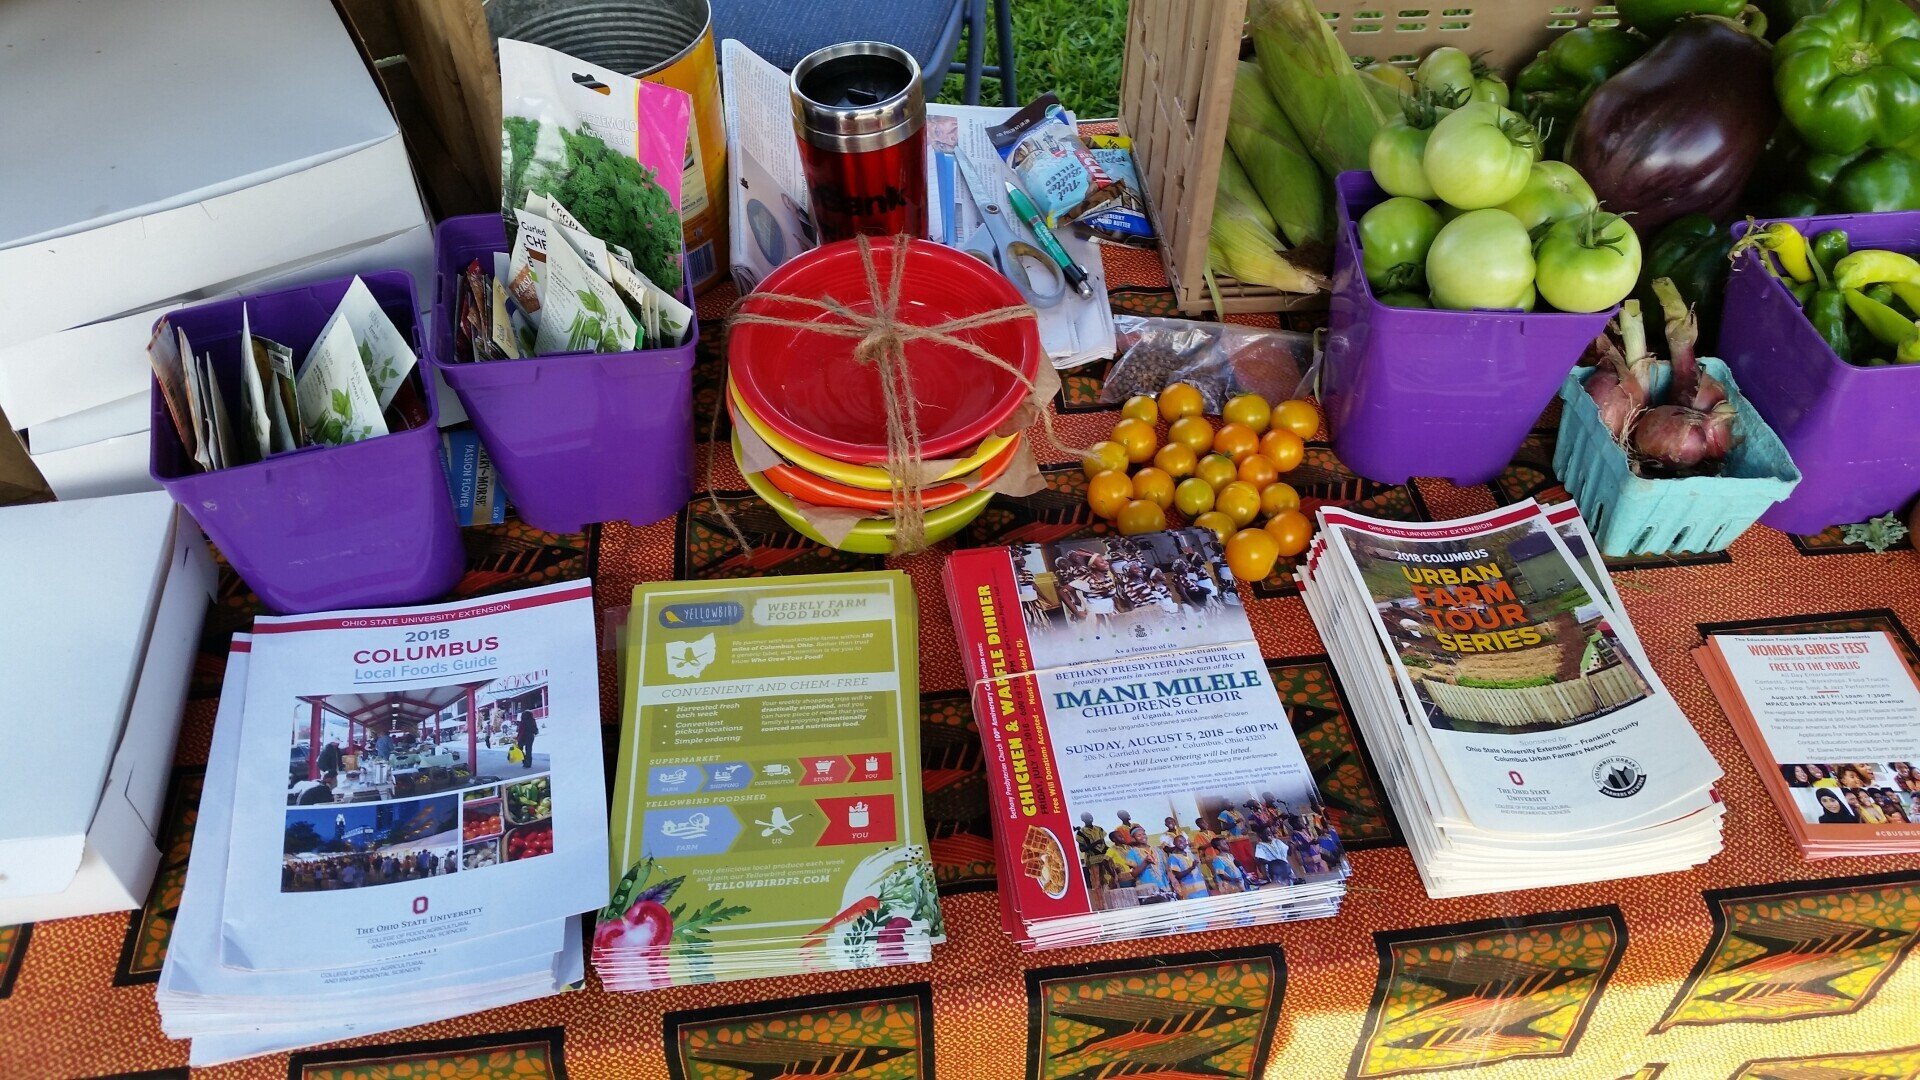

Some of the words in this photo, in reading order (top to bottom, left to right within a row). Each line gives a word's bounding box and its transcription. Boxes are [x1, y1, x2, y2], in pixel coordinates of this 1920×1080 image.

[521, 221, 546, 237] Curled
[463, 444, 475, 476] PASSION
[460, 478, 472, 508] FLOWER
[1368, 524, 1385, 533] OHIO
[1385, 527, 1406, 536] STATE
[1450, 522, 1493, 535] EXTENSION
[1397, 551, 1422, 563] 2018
[1423, 548, 1489, 563] COLUMBUS
[1401, 562, 1503, 585] URBAN
[1410, 581, 1517, 607] FARM
[342, 619, 367, 627] OHIO
[370, 618, 398, 626] STATE
[401, 612, 456, 624] UNIVERSITY
[458, 603, 511, 618] EXTENSION
[684, 605, 738, 620] YELLOWBIRD
[767, 601, 824, 612] WEEKLY
[829, 599, 867, 609] FARM
[767, 611, 808, 621] FOOD
[812, 609, 841, 618] BOX
[978, 585, 1001, 645] DINNER
[1423, 603, 1529, 632] TOUR
[405, 628, 450, 643] 2018
[1436, 626, 1542, 652] SERIES
[353, 636, 499, 664] COLUMBUS
[1019, 650, 1027, 658] by
[1132, 645, 1156, 653] feature
[1747, 644, 1794, 656] WOMEN
[1795, 644, 1804, 655] &
[1841, 642, 1870, 653] FEST
[355, 666, 396, 680] Local
[401, 663, 448, 677] Foods
[453, 655, 497, 670] Guide
[1055, 667, 1110, 681] BETHANY
[1111, 657, 1196, 674] PRESBYTERIAN
[1198, 653, 1245, 665] CHURCH
[1769, 663, 1792, 672] FREE
[1793, 662, 1805, 671] TO
[1806, 662, 1825, 671] THE
[1826, 661, 1861, 670] PUBLIC
[661, 684, 754, 698] CONVENIENT
[756, 682, 787, 692] AND
[790, 677, 869, 691] CHEM-FREE
[990, 649, 1015, 716] WAFFLE
[1053, 683, 1151, 710] IMANI
[1153, 669, 1262, 698] MILELE
[1073, 678, 1101, 687] proudly
[1102, 675, 1133, 684] presents
[1026, 686, 1036, 704] Music
[1082, 698, 1182, 718] CHILDRENS
[1185, 690, 1243, 706] CHOIR
[677, 704, 718, 712] Harvested
[987, 691, 999, 727] Anniversary
[1142, 711, 1173, 721] Uganda,
[675, 720, 723, 728] Convenient
[675, 727, 704, 736] pickup
[705, 725, 743, 733] locations
[1006, 720, 1020, 732] &
[1033, 714, 1046, 745] Accepted
[674, 738, 703, 746] Simple
[1065, 740, 1126, 756] SUNDAY,
[1128, 733, 1183, 748] AUGUST
[1185, 732, 1197, 741] 5,
[1198, 728, 1224, 739] 2018
[1235, 724, 1258, 735] 6:00
[1260, 722, 1279, 732] PM
[1109, 749, 1140, 758] Garfield
[1142, 746, 1170, 755] Avenue
[1182, 740, 1224, 750] Columbus,
[1225, 736, 1244, 745] Ohio
[1244, 733, 1267, 742] 43203
[1466, 745, 1482, 753] Ohio
[1501, 746, 1536, 755] University
[1537, 743, 1573, 753] Extension
[1580, 732, 1611, 745] Franklin
[1612, 720, 1639, 736] County
[649, 755, 721, 765] SUPERMARKET
[997, 744, 1006, 761] Church
[1114, 760, 1131, 768] Free
[1132, 757, 1148, 766] Will
[1150, 755, 1168, 764] Love
[1203, 749, 1218, 758] will
[1219, 748, 1229, 756] be
[1494, 755, 1528, 763] Columbus
[1529, 754, 1551, 763] Urban
[1552, 750, 1583, 761] Farmers
[1584, 739, 1617, 753] Network
[1040, 746, 1053, 779] Donations
[1002, 762, 1012, 796] Presbyterian
[1008, 738, 1037, 817] CHICKEN
[1047, 781, 1056, 797] Will
[646, 798, 711, 808] YELLOWBIRD
[713, 793, 767, 803] FOODSHED
[1010, 796, 1018, 819] Bethany
[707, 875, 830, 891] YELLOWBIRDFS.COM
[401, 918, 428, 927] STATE
[430, 907, 483, 922] UNIVERSITY
